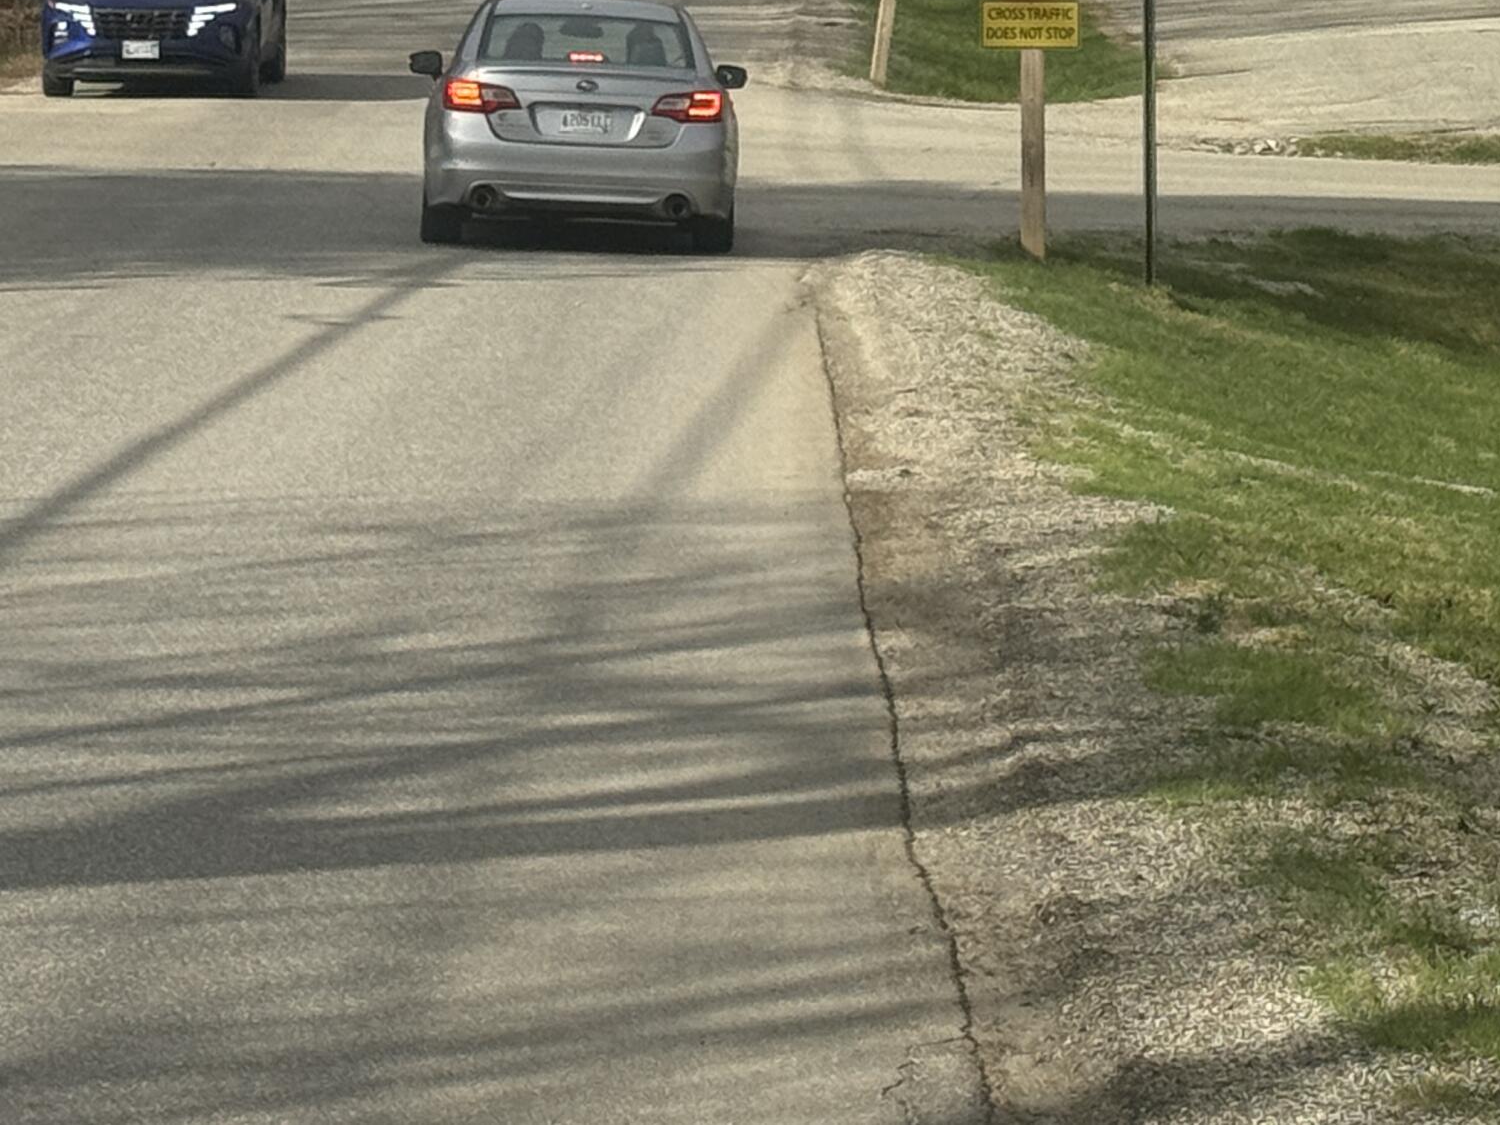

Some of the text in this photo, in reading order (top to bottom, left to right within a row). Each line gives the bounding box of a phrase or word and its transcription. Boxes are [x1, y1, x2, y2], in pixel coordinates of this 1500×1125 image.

[987, 7, 1074, 21] CROSS TRAFFIC
[986, 26, 1076, 40] DOES NOT STOP
